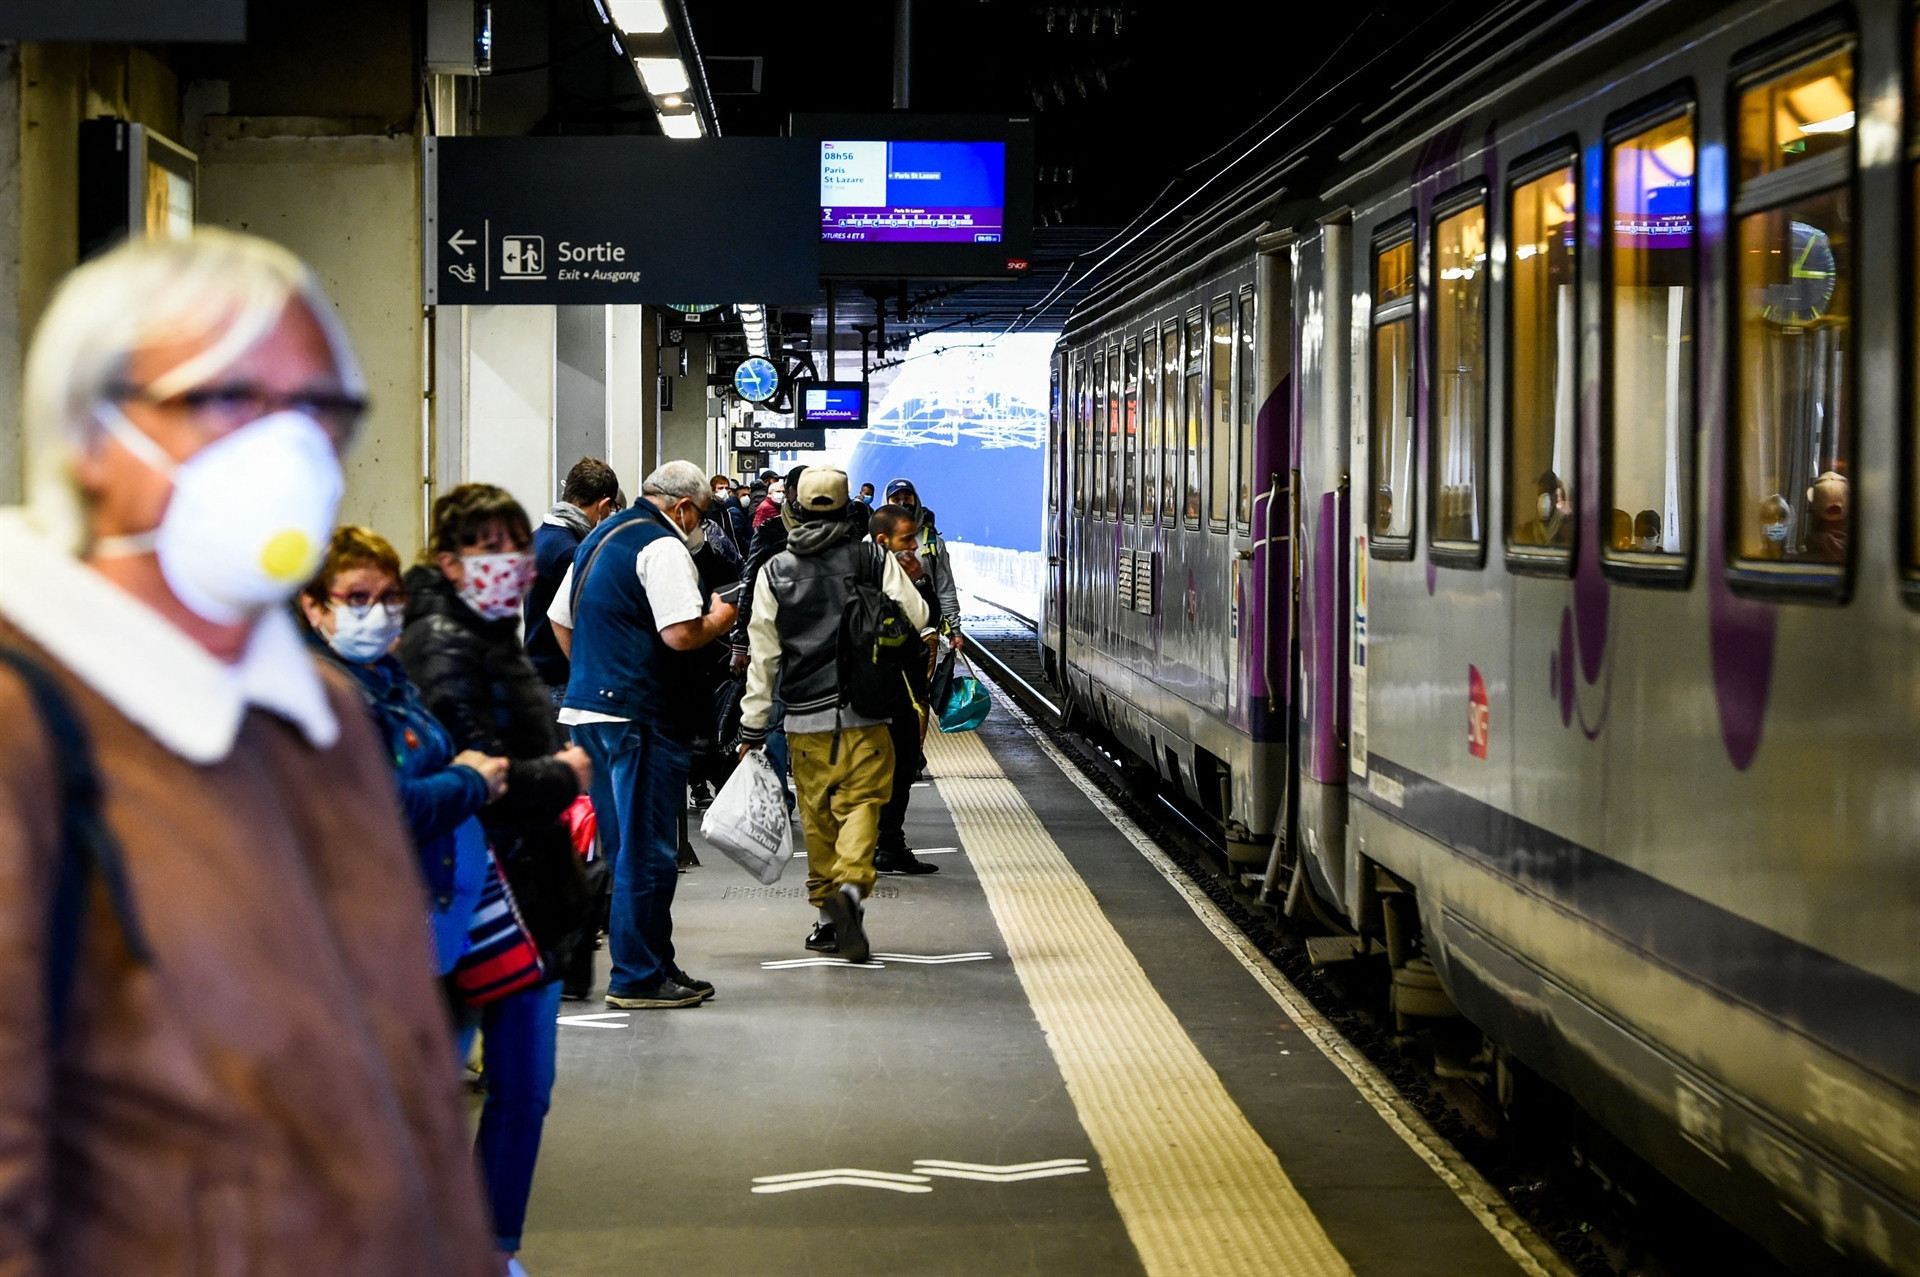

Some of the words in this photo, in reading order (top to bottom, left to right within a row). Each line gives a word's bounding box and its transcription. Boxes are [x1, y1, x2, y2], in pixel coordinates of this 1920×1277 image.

[824, 152, 854, 160] 08h56
[824, 166, 846, 174] Paris
[557, 241, 626, 262] Sortie
[1007, 262, 1026, 270] SNCF
[557, 269, 580, 280] Exit
[591, 269, 641, 283] Ausgang
[753, 431, 776, 439] Sortie
[753, 440, 815, 448] Correspondance
[744, 460, 752, 470] C
